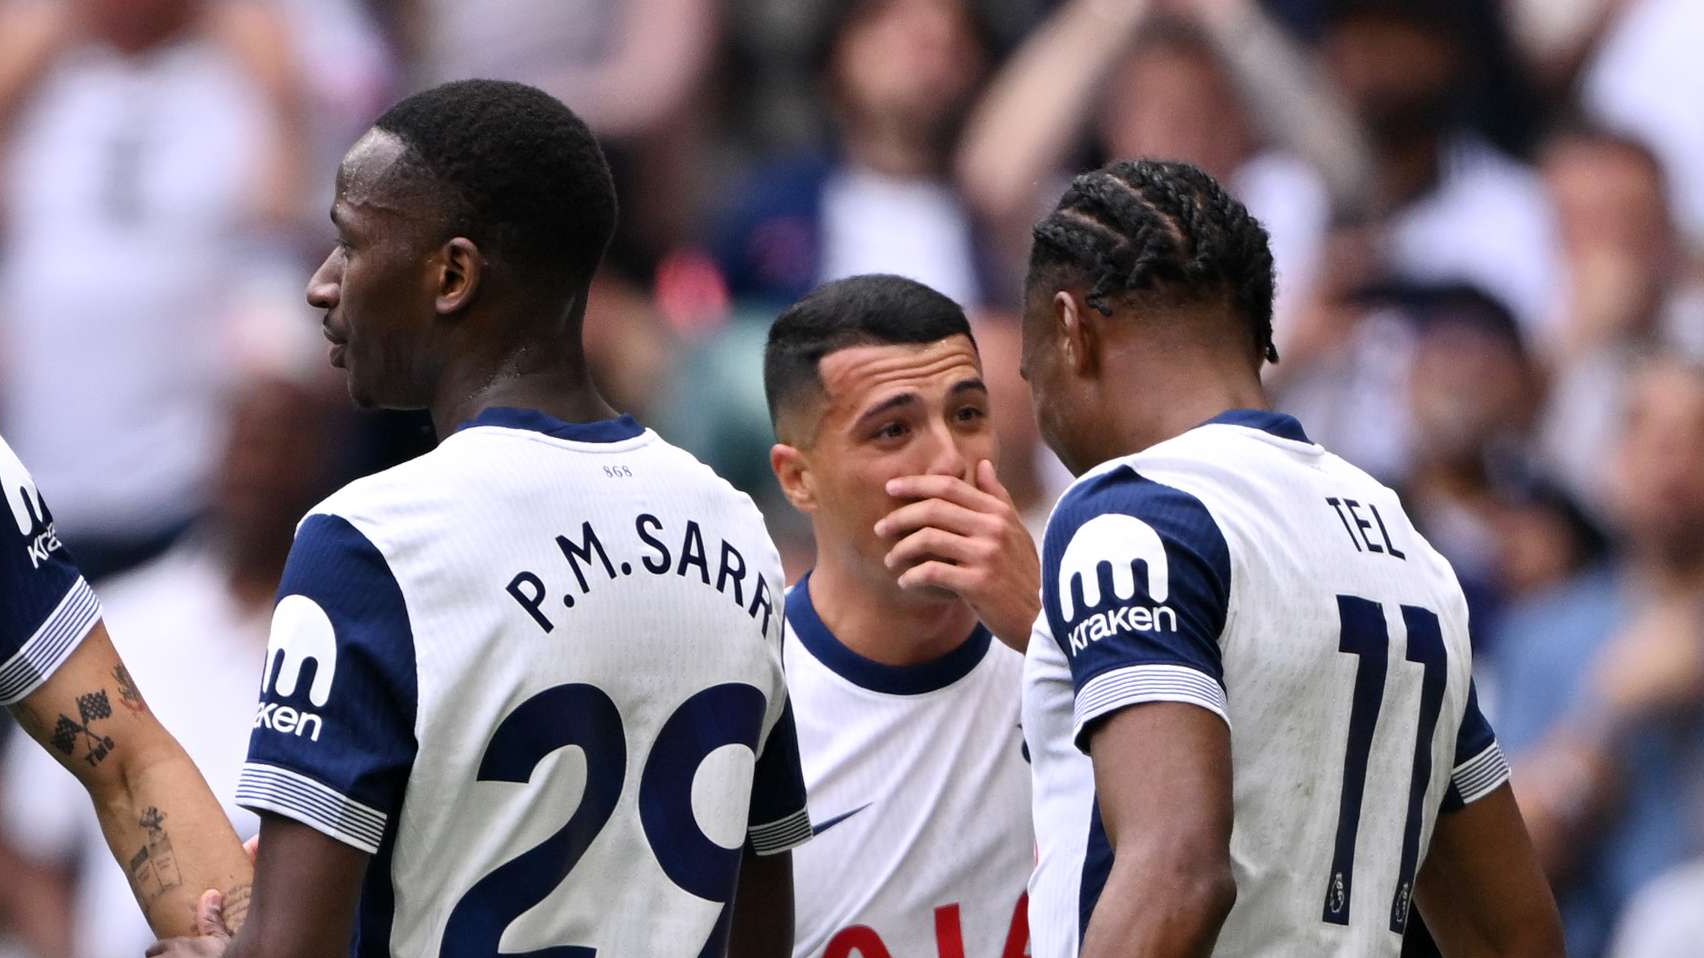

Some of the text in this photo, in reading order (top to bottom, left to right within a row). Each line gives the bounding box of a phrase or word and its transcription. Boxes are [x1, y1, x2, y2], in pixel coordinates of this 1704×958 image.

[603, 464, 633, 478] 868
[1325, 496, 1407, 561] TEL
[1068, 605, 1178, 657] kraken
[1322, 594, 1448, 935] 11
